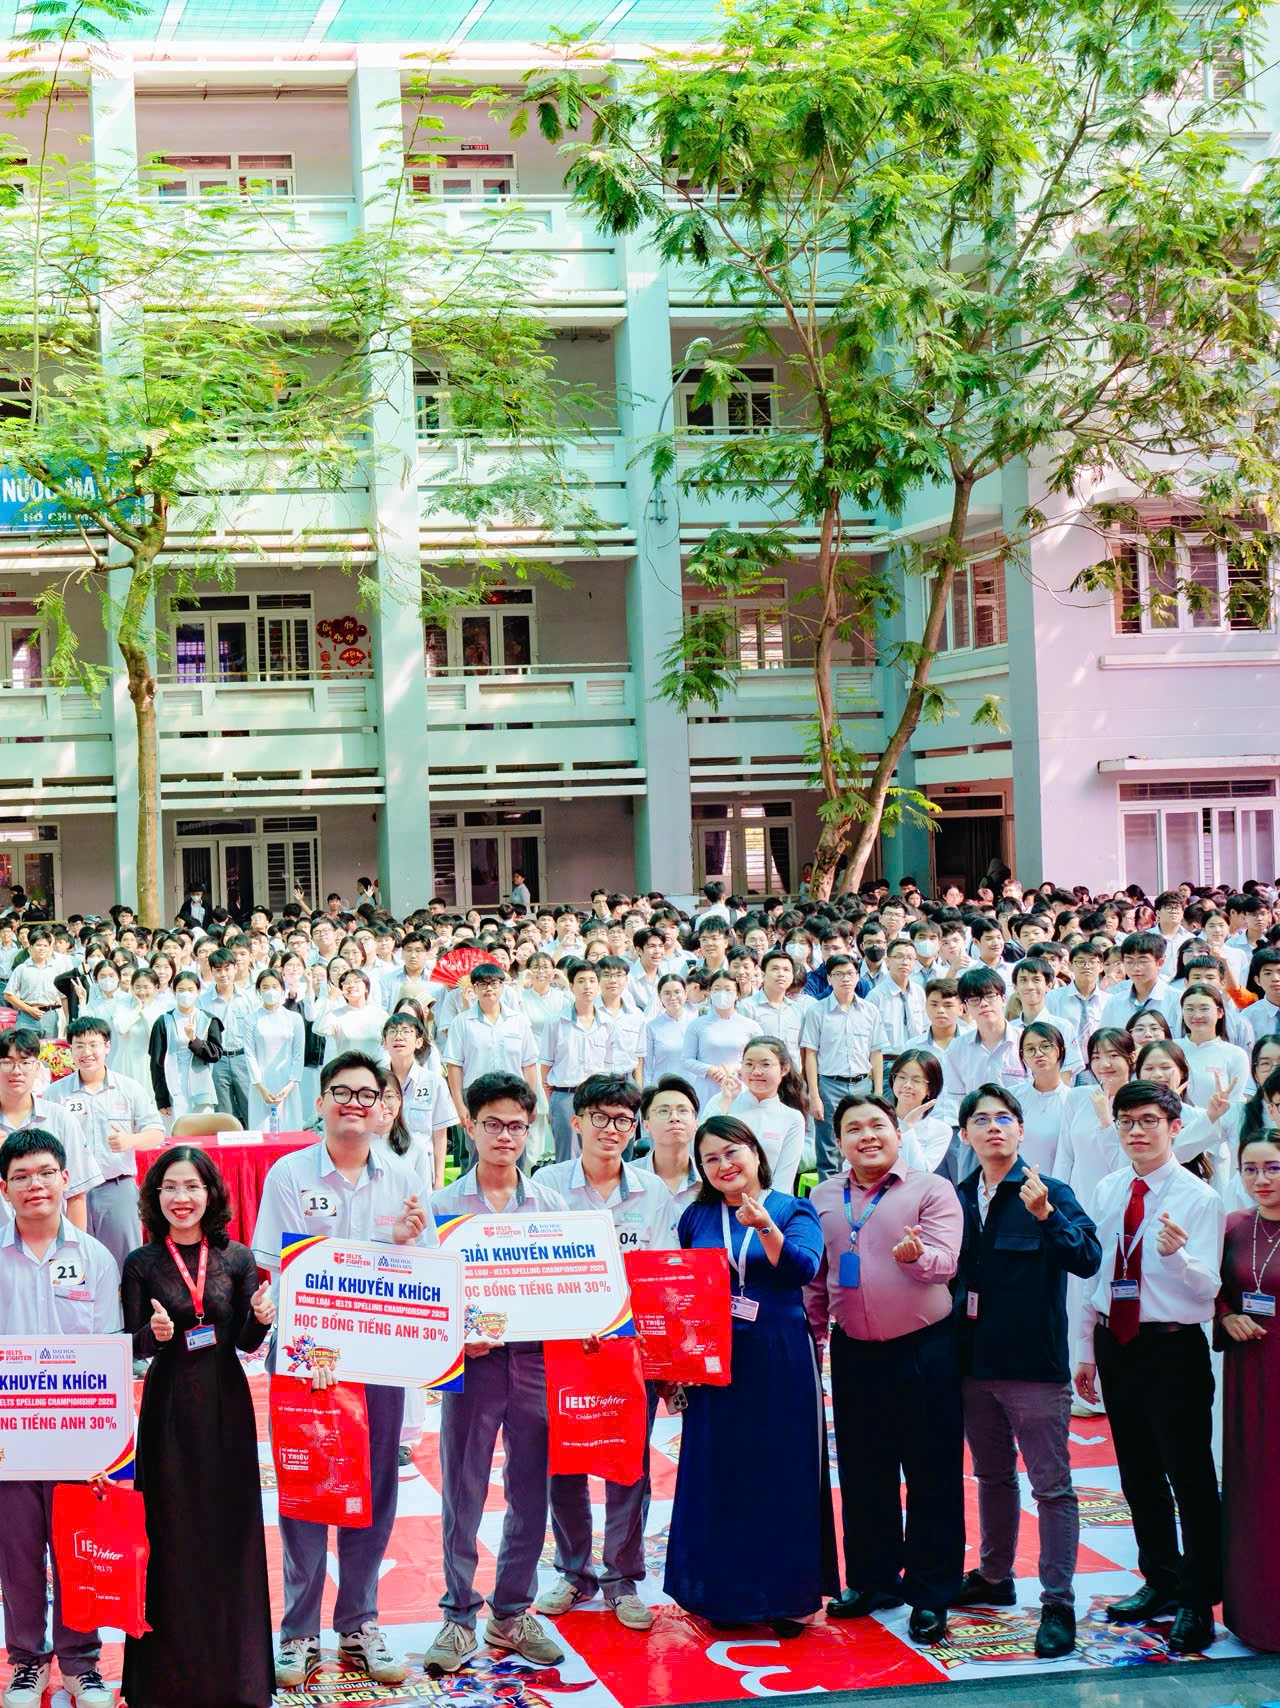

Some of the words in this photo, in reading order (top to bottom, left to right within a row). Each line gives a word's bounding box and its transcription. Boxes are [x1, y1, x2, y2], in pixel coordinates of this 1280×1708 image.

[417, 1088, 429, 1097] 22
[70, 1103, 83, 1112] 23
[309, 1197, 329, 1210] 13
[620, 1232, 638, 1245] 04
[493, 1242, 549, 1262] KHUYẾN
[552, 1242, 596, 1259] KHÍCH
[346, 1259, 371, 1267] FIGHTER
[494, 1267, 511, 1275] IELTS
[511, 1265, 541, 1275] SPELLING
[57, 1265, 78, 1279] 21
[305, 1270, 334, 1291] GIẢI
[338, 1275, 394, 1298] KHUYẾN
[399, 1282, 441, 1302] KHÍCH
[484, 1281, 516, 1297] BỔNG
[519, 1280, 554, 1296] TIẾNG
[557, 1282, 582, 1294] ANH
[584, 1281, 611, 1293] 30%
[335, 1299, 352, 1309] IELTS
[353, 1301, 383, 1312] SPELLING
[383, 1304, 431, 1317] CHAMPIONSHIP
[294, 1313, 319, 1331] HỌC
[322, 1312, 354, 1333] BỔNG
[358, 1317, 392, 1336] TIẾNG
[395, 1326, 419, 1339] ANH
[423, 1327, 449, 1342] 30%
[0, 1369, 58, 1390] KHUYẾN
[63, 1371, 107, 1390] KHÍCH
[16, 1398, 46, 1407] SPELLING
[48, 1398, 96, 1407] CHAMPIONSHIP
[20, 1413, 57, 1430] TIẾNG
[60, 1417, 86, 1430] ANH
[89, 1416, 117, 1430] 30%
[310, 1681, 382, 1692] AMPIONSHIP
[375, 1680, 444, 1700] IELTS
[275, 1689, 374, 1706] SPELLING
